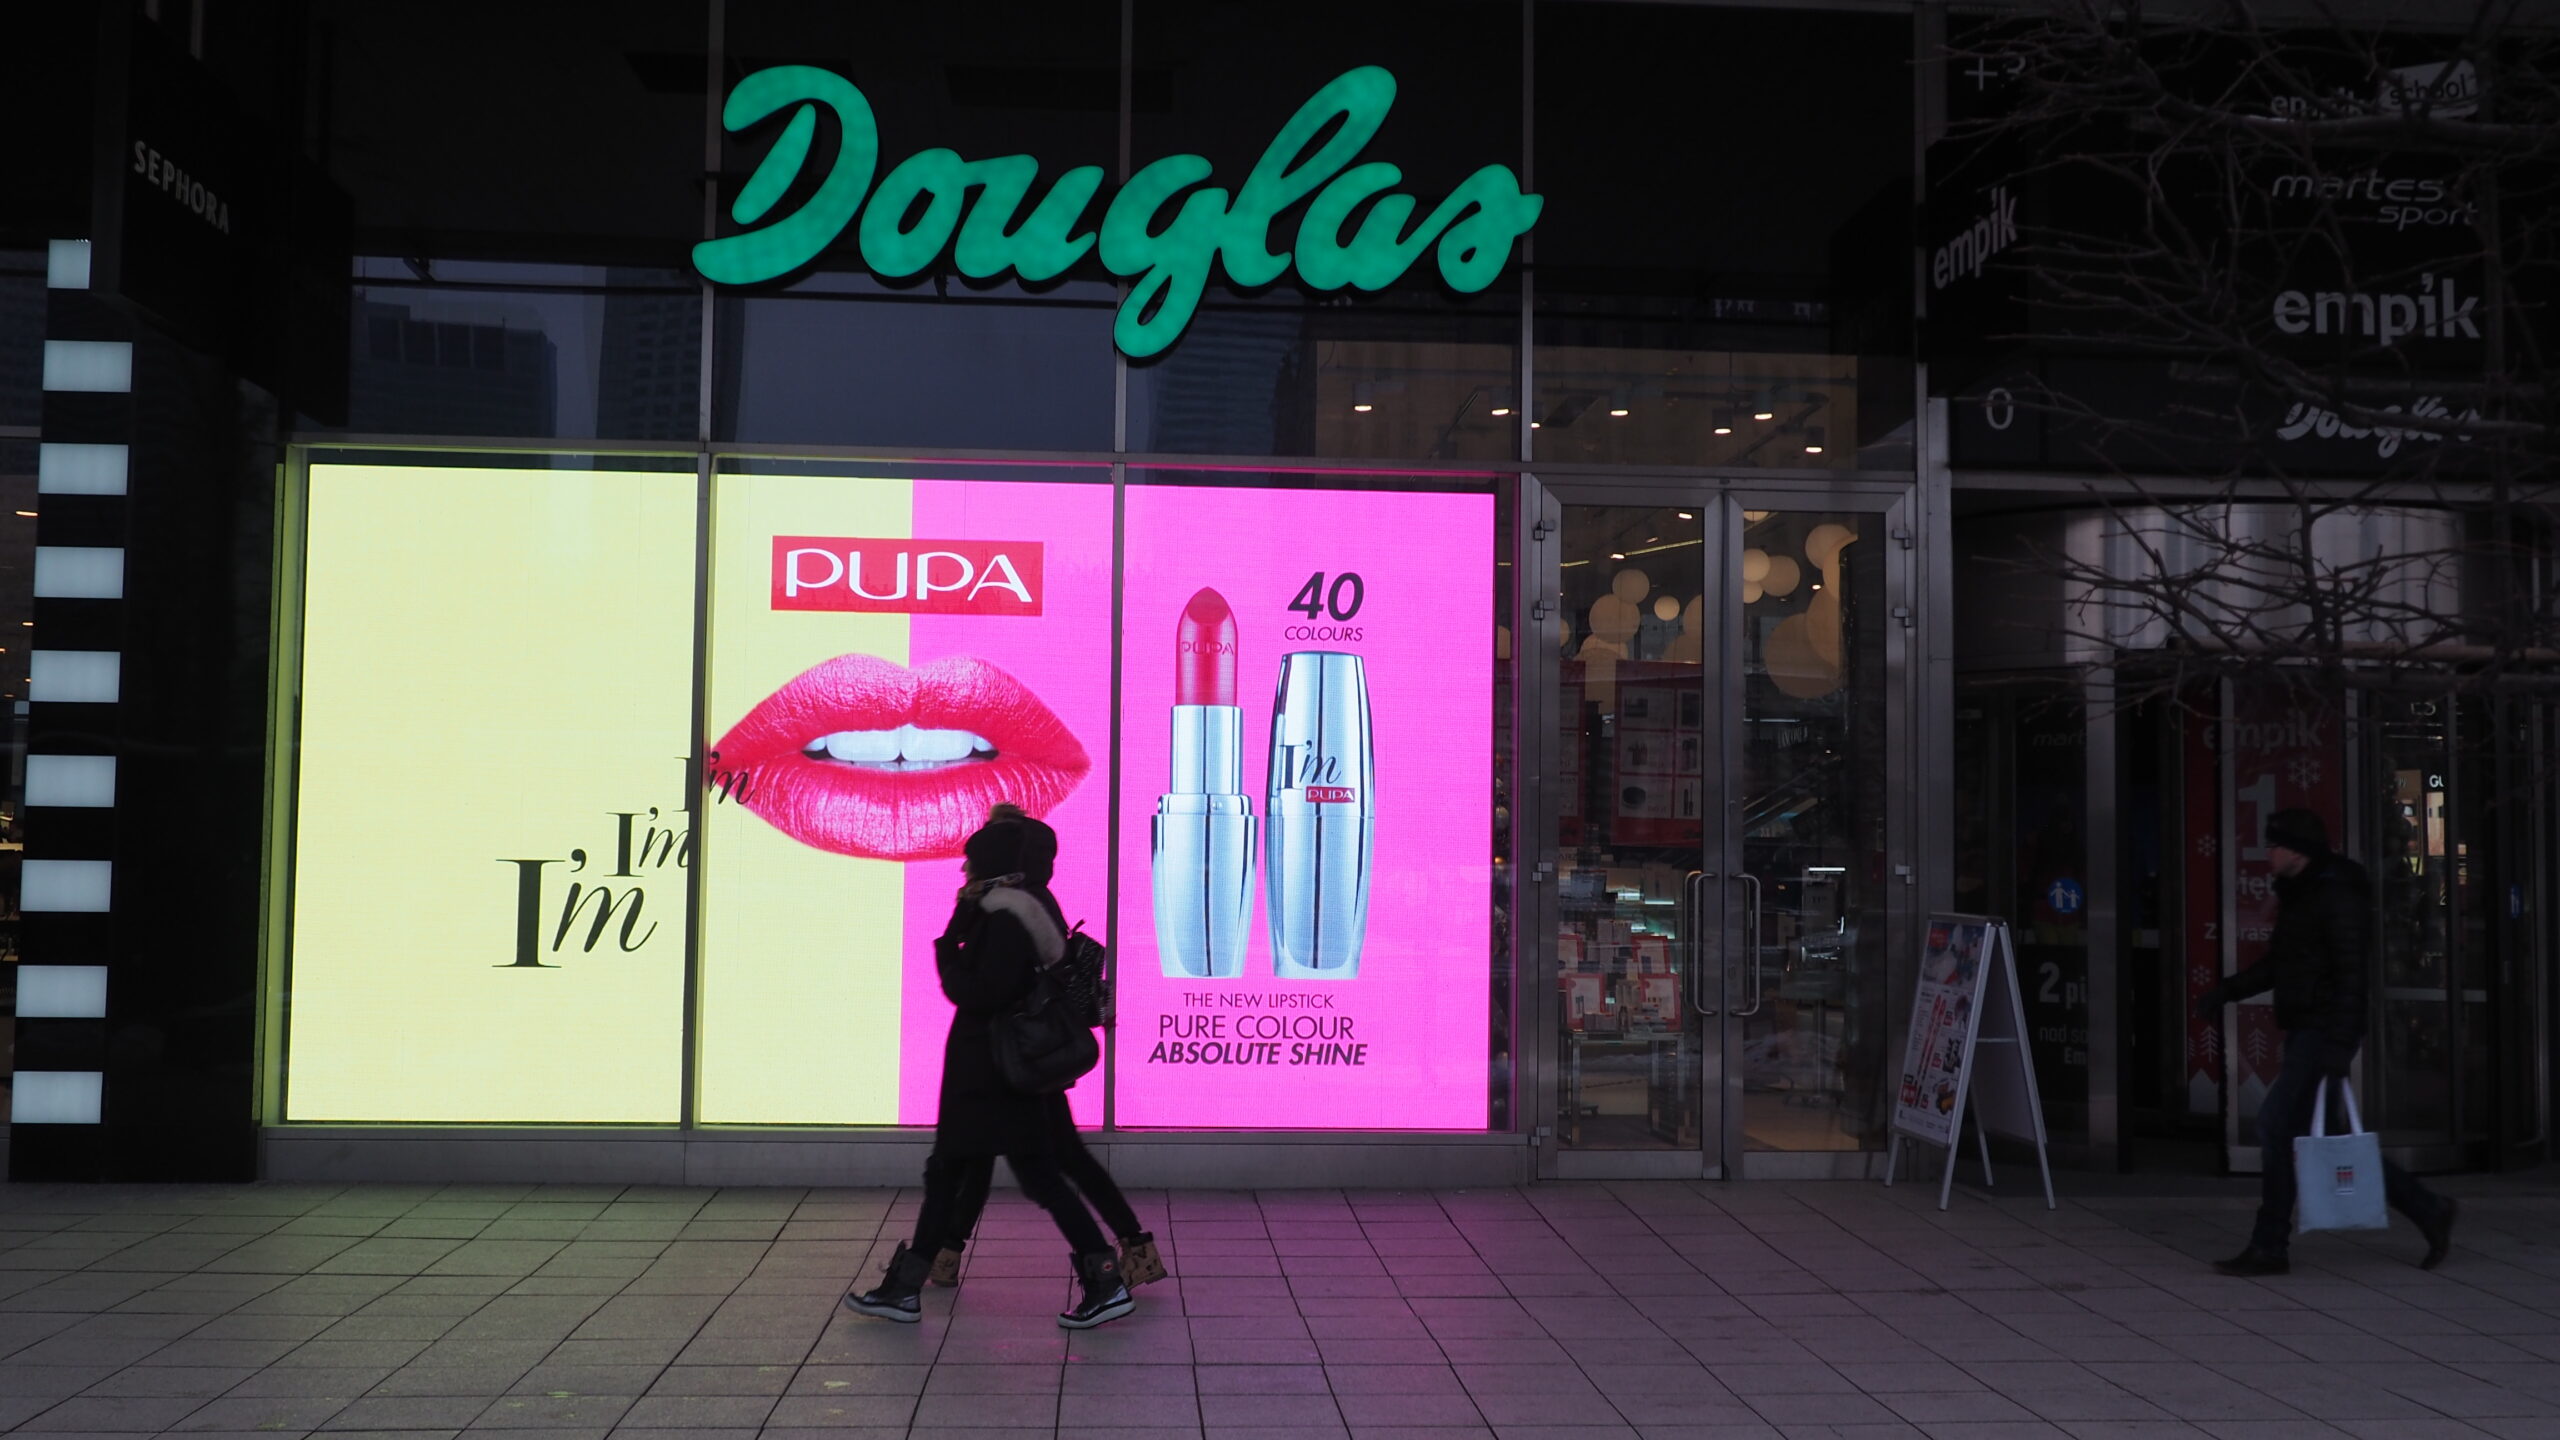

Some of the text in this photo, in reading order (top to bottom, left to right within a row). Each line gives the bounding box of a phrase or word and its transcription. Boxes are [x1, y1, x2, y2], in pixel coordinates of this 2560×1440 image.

[133, 139, 231, 236] SEPHORA
[2271, 168, 2446, 203] martes
[692, 64, 1545, 358] Douglas
[2377, 201, 2479, 233] sport
[786, 547, 1033, 603] PUPA
[1287, 571, 1365, 623] 40
[1181, 641, 1235, 656] PUPA
[1284, 625, 1364, 643] COLOURS
[1307, 788, 1355, 801] PUPA
[2238, 773, 2278, 862] 1
[1183, 992, 1335, 1010] THE NEW LIPSTICK
[2039, 960, 2088, 1011] 2 pi
[1159, 1014, 1355, 1041] PURE COLOUR
[1147, 1041, 1369, 1067] ABSOLUTE SHINE
